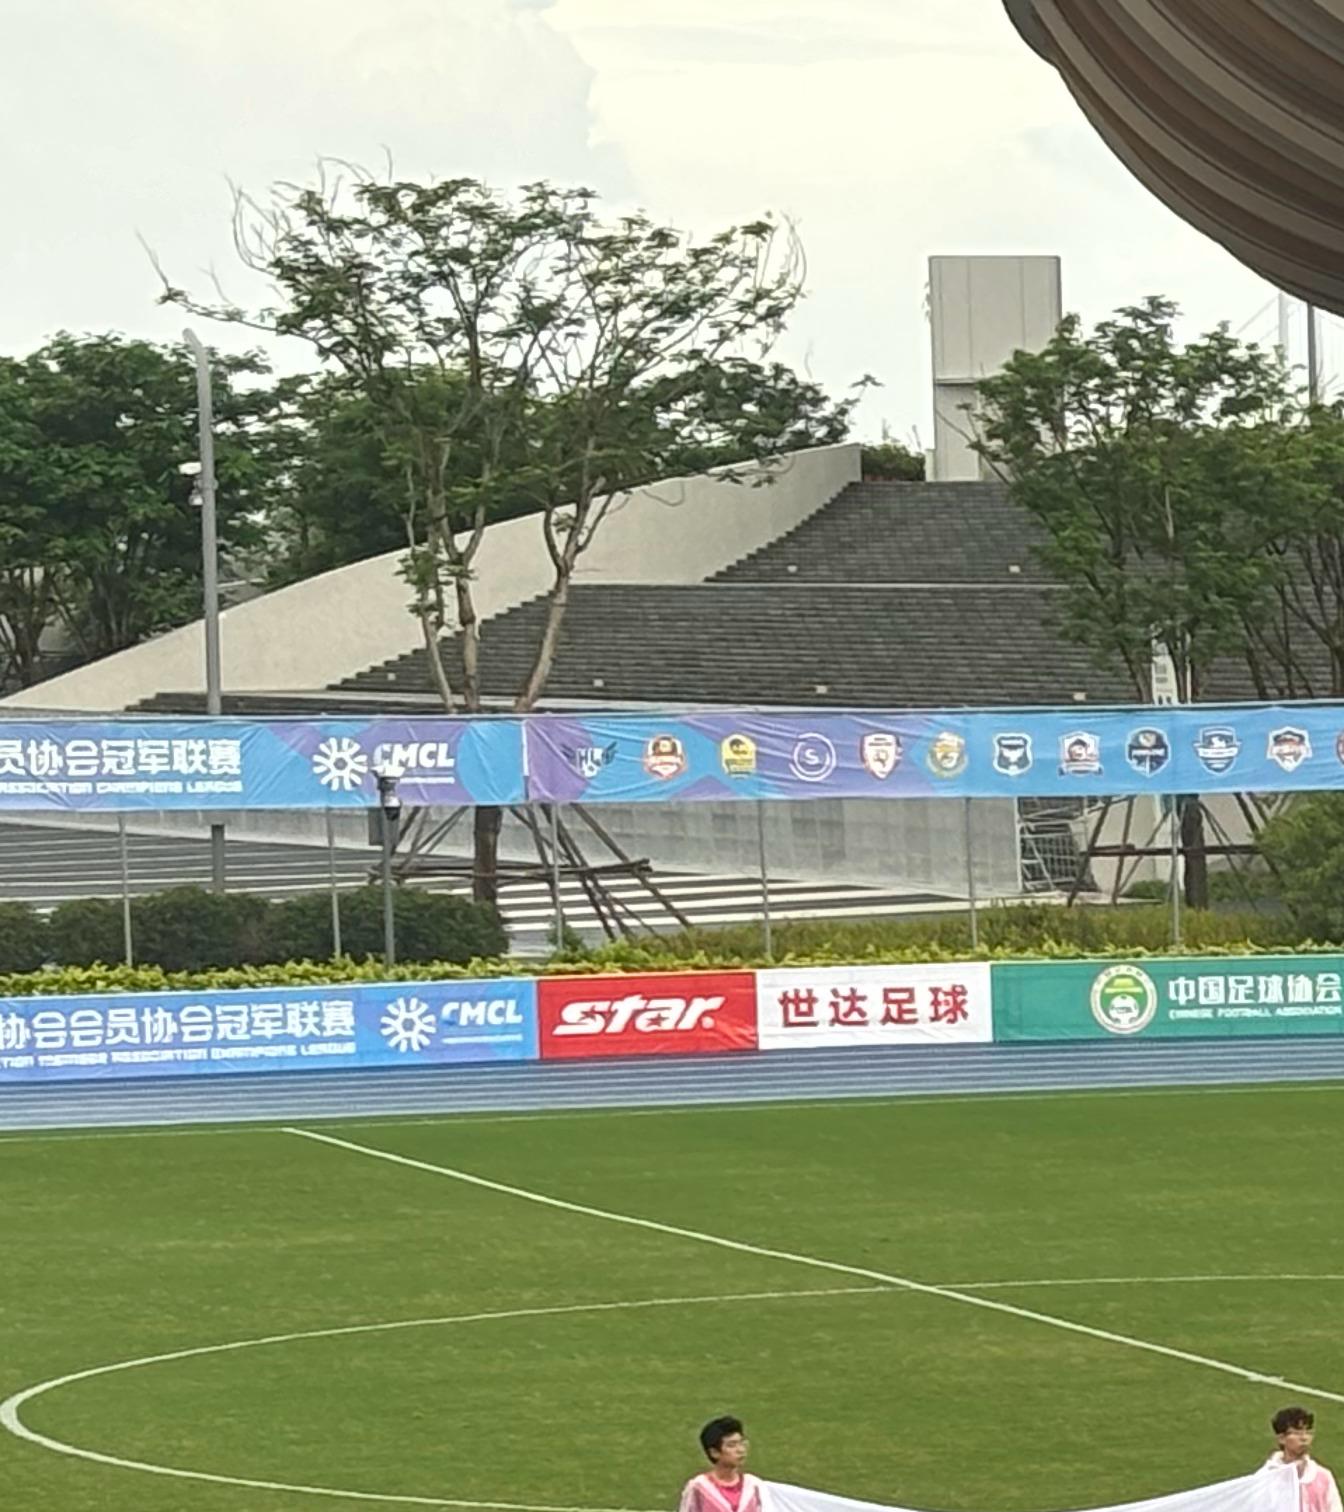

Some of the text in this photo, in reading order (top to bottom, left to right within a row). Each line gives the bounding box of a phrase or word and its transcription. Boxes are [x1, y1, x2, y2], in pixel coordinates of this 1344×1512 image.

[0, 739, 241, 776] 员协会冠军联赛
[778, 984, 969, 1028] 世达足球
[1168, 973, 1342, 1005] 中国足球协会
